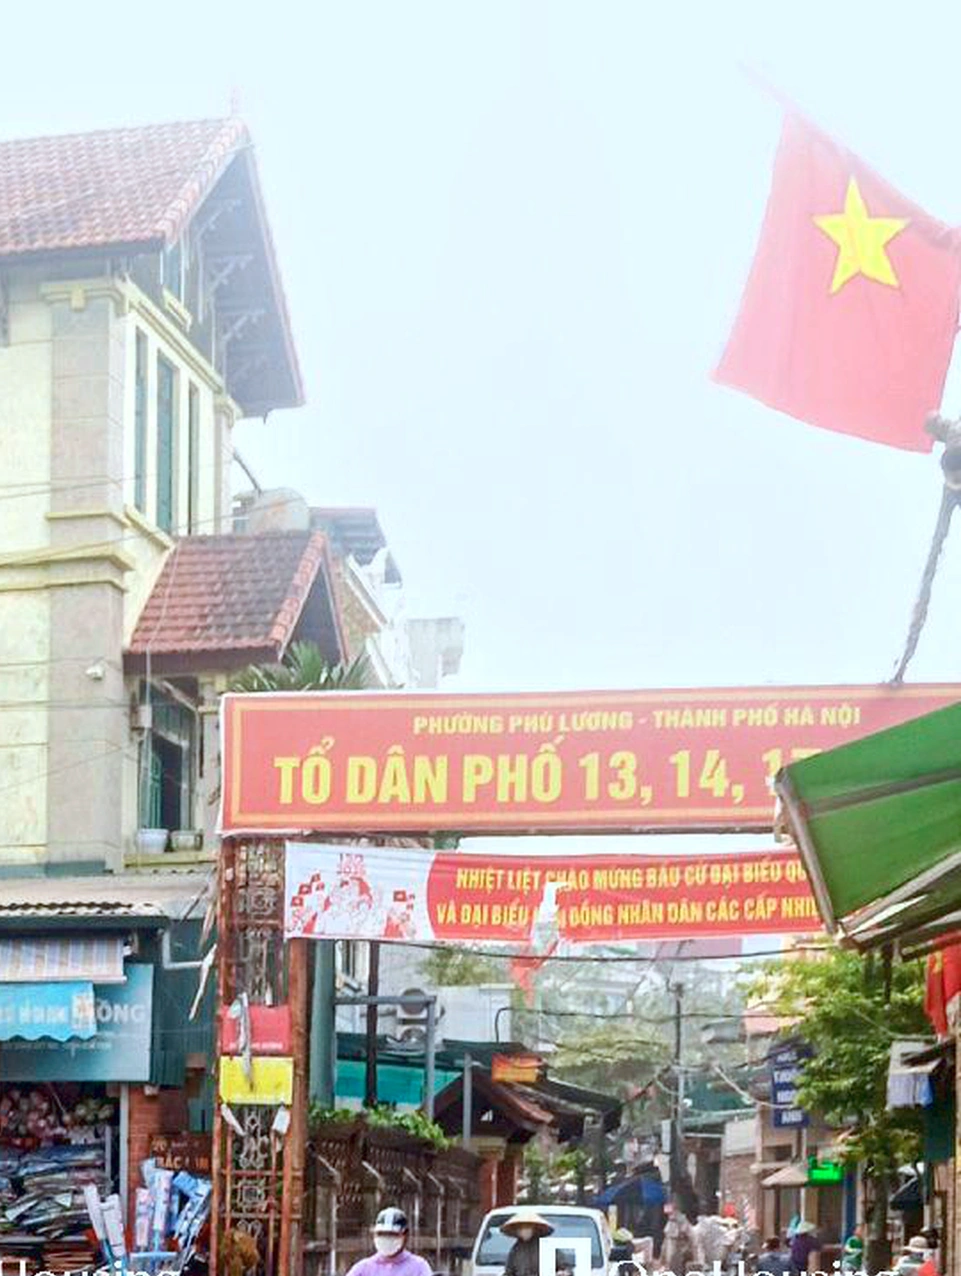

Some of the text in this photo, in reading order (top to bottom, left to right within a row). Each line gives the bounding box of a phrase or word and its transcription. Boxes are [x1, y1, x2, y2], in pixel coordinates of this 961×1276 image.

[413, 711, 504, 735] PHƯỜNG
[509, 710, 552, 733] PHÚ
[558, 710, 633, 732] LƯƠNG
[652, 706, 727, 729] THÀNH
[732, 701, 780, 727] PHỐ
[784, 703, 814, 726] HÀ
[820, 702, 861, 729] NỘI
[274, 735, 335, 804] TỔ
[346, 745, 448, 804] DÂN
[462, 734, 564, 803] PHỐ
[578, 750, 653, 806] 13,
[669, 749, 744, 804] 14,
[456, 865, 503, 894] NHIỆT
[507, 865, 542, 895] LIỆT
[436, 898, 457, 924] VÀ
[461, 903, 489, 928] ĐẠI
[491, 897, 529, 926] BIỂU
[618, 899, 664, 926] NHÂN
[667, 897, 703, 924] DÂN
[706, 896, 739, 922] CÁC
[743, 891, 777, 921] CẤP
